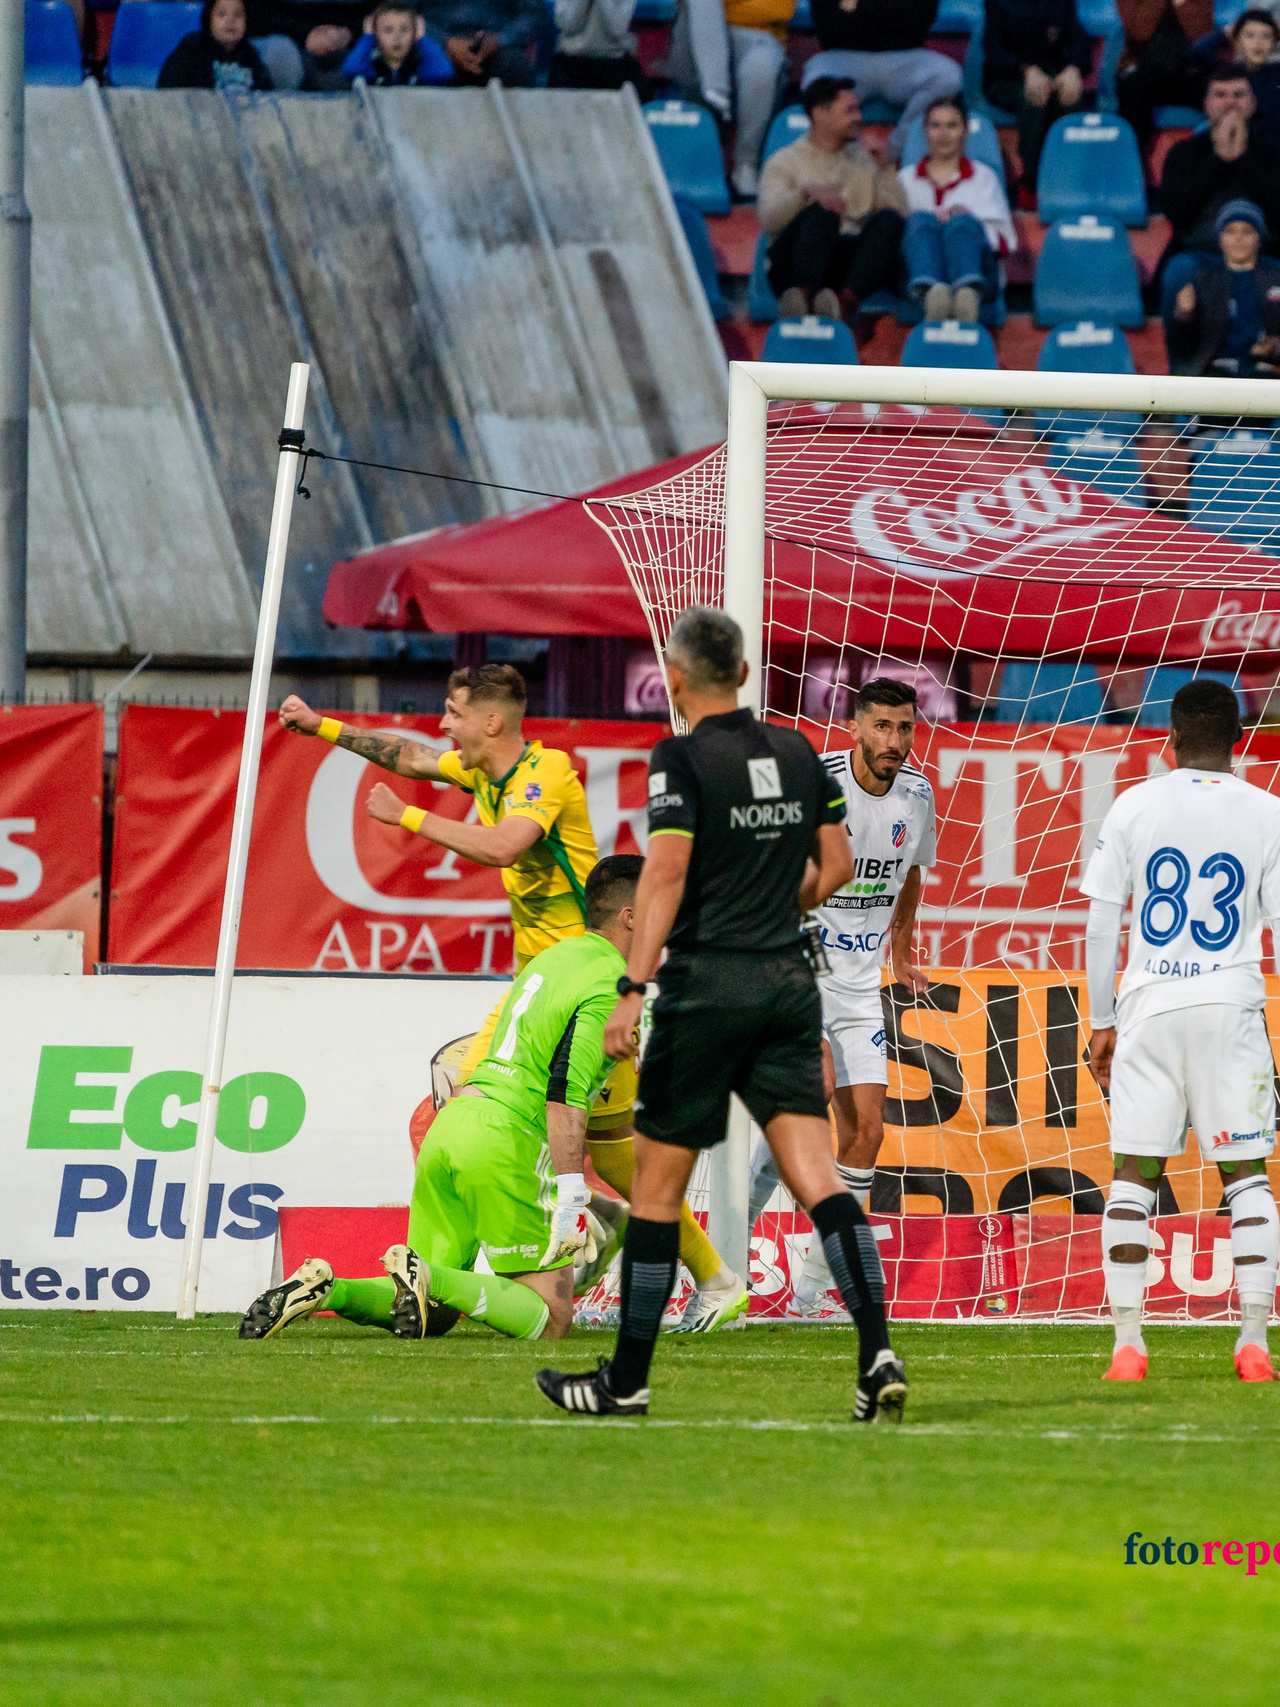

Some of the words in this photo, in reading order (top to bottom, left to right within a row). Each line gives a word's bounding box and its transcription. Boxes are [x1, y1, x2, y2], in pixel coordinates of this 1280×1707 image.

[730, 801, 803, 829] NORDIS
[1141, 846, 1245, 952] 83
[312, 921, 449, 972] APA
[495, 973, 544, 1062] 1
[26, 1044, 307, 1154] Eco
[1231, 1131, 1260, 1142] Smart
[54, 1158, 285, 1241] Plus
[488, 1245, 518, 1255] Smart
[520, 1244, 539, 1253] Eco
